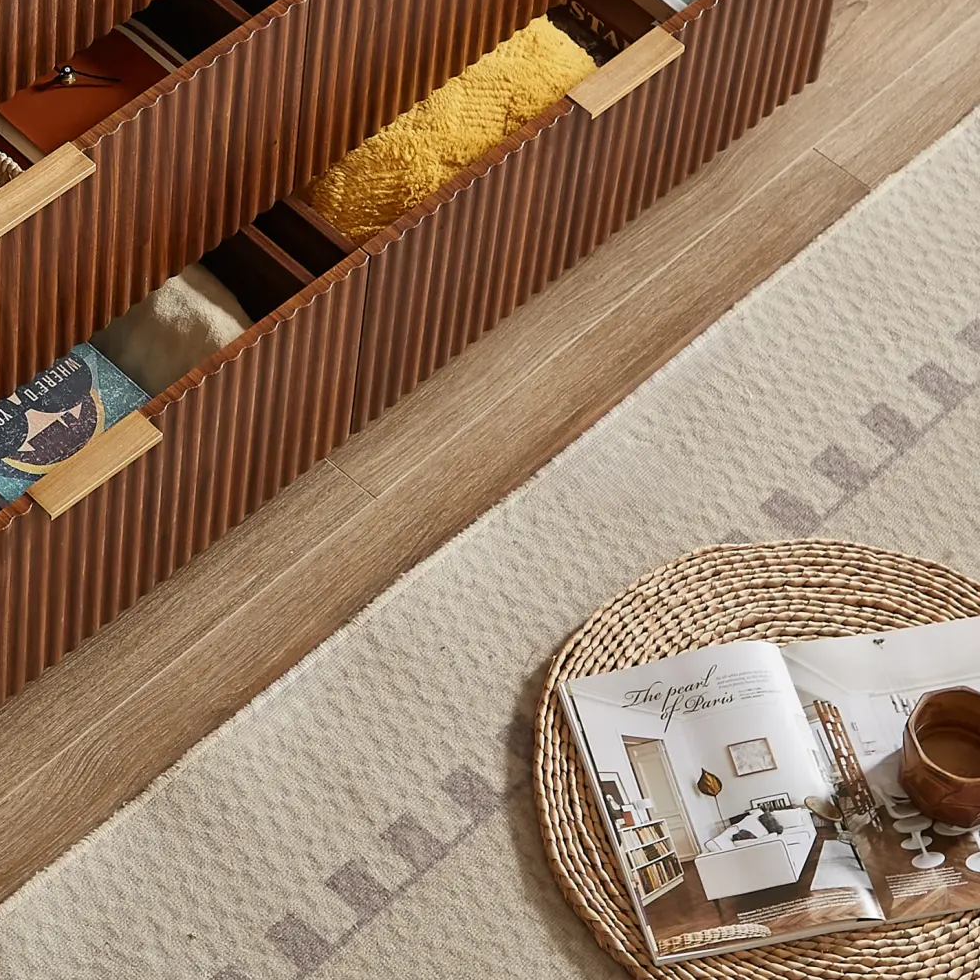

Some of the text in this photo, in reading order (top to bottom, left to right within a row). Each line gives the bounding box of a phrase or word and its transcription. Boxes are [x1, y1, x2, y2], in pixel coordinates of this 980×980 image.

[23, 356, 83, 402] WHERE'D
[621, 680, 664, 709] The
[661, 664, 718, 713] pearl
[660, 695, 685, 734] of
[683, 690, 736, 715] Paris
